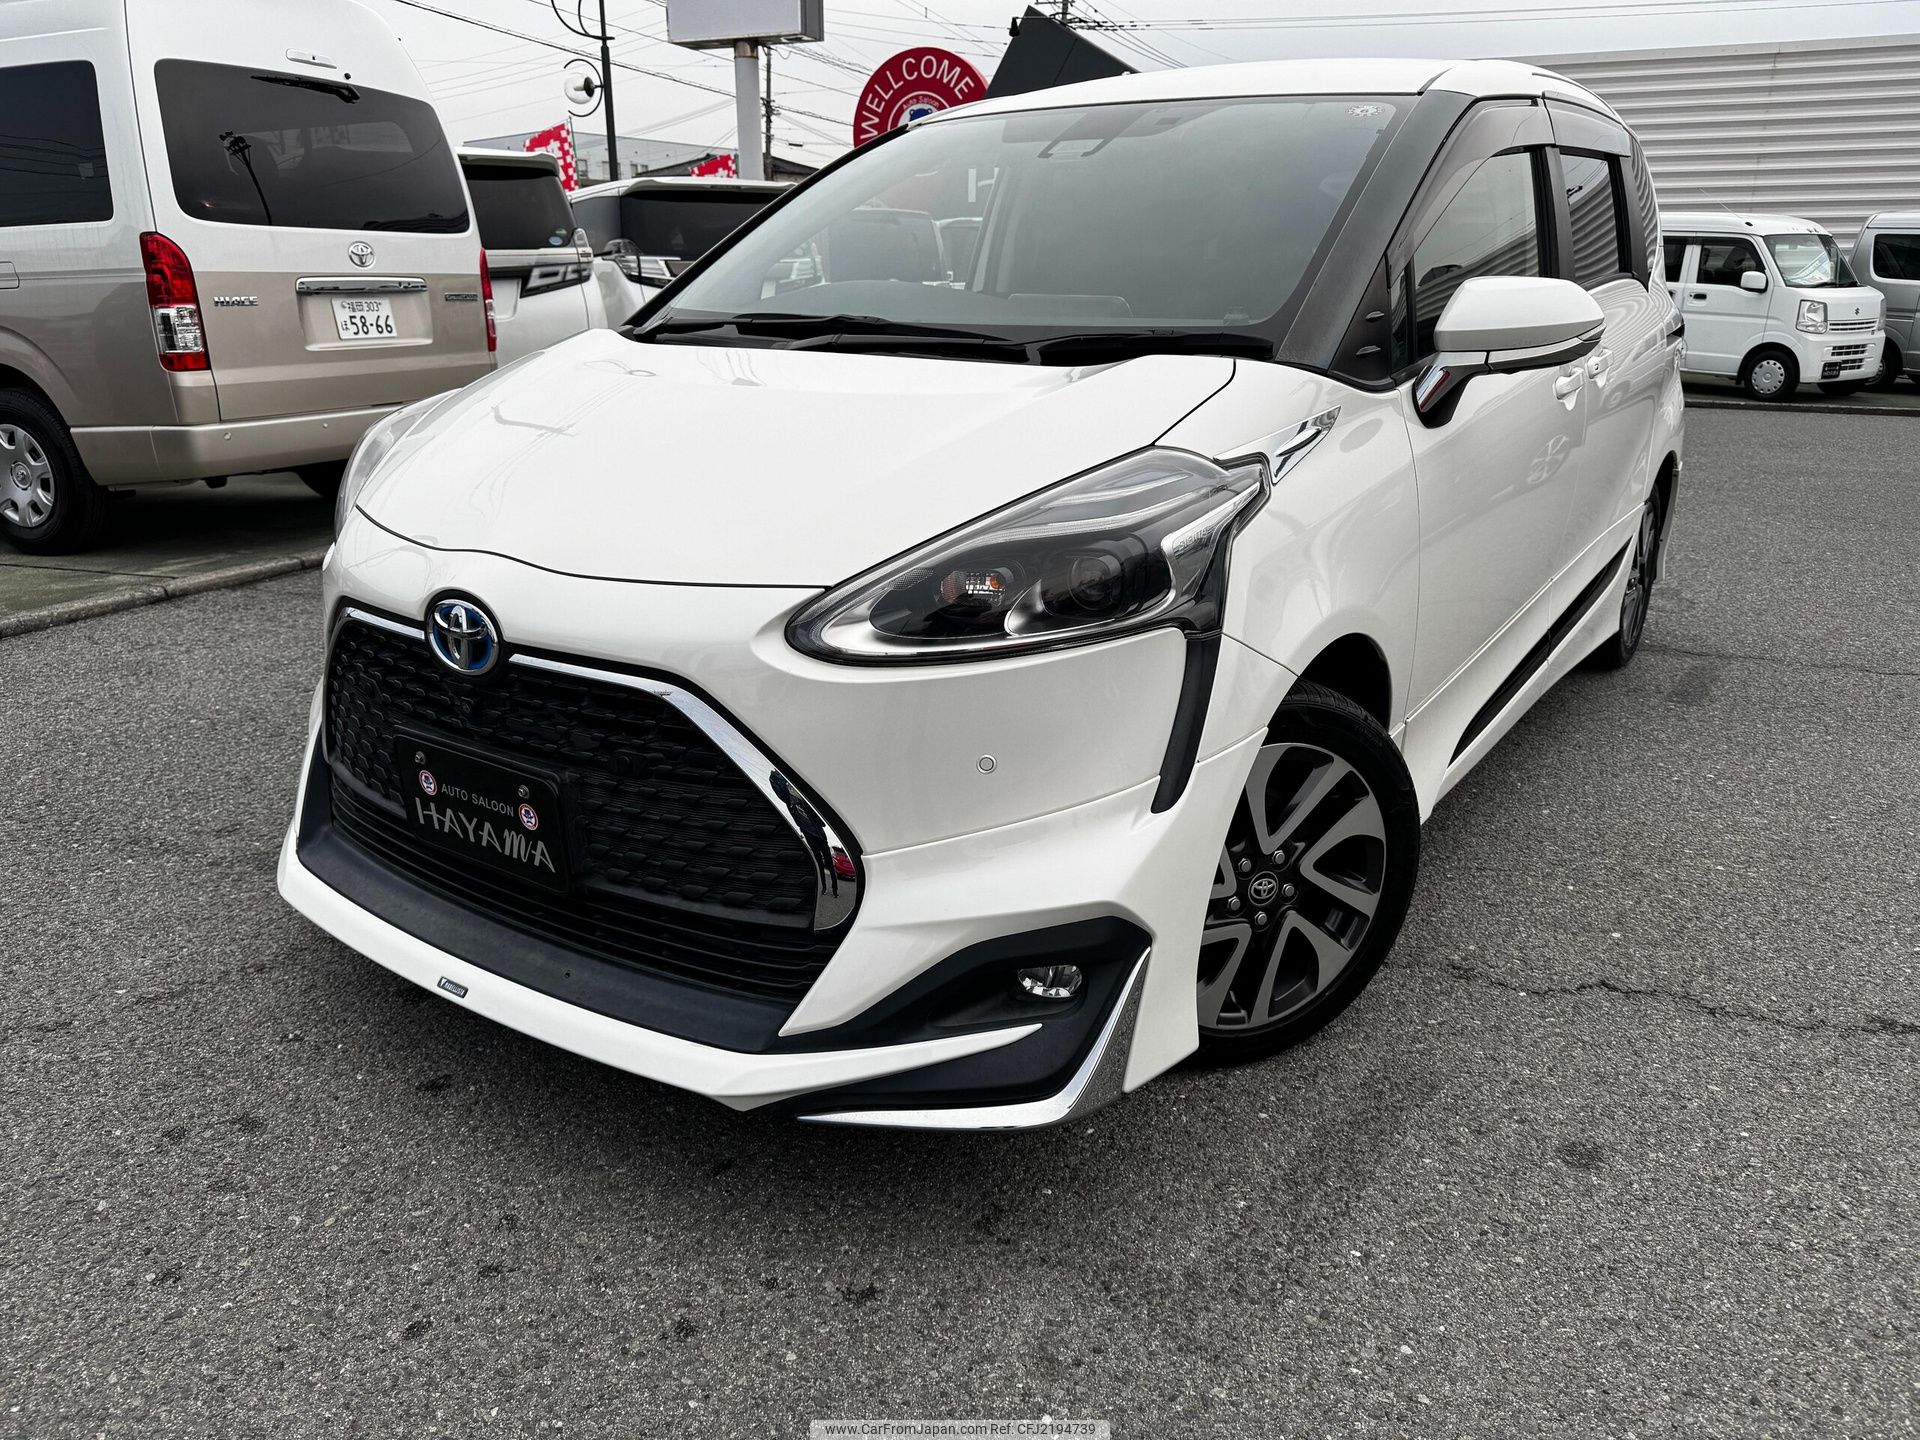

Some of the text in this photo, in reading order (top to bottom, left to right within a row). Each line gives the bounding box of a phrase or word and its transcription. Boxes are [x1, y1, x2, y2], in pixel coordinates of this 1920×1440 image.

[860, 55, 975, 139] WELLCOME
[213, 296, 258, 307] HIACE
[364, 301, 380, 312] 303
[349, 314, 393, 335] 58-66
[441, 784, 515, 817] AUTO SALOON
[415, 797, 556, 873] HAYAMA
